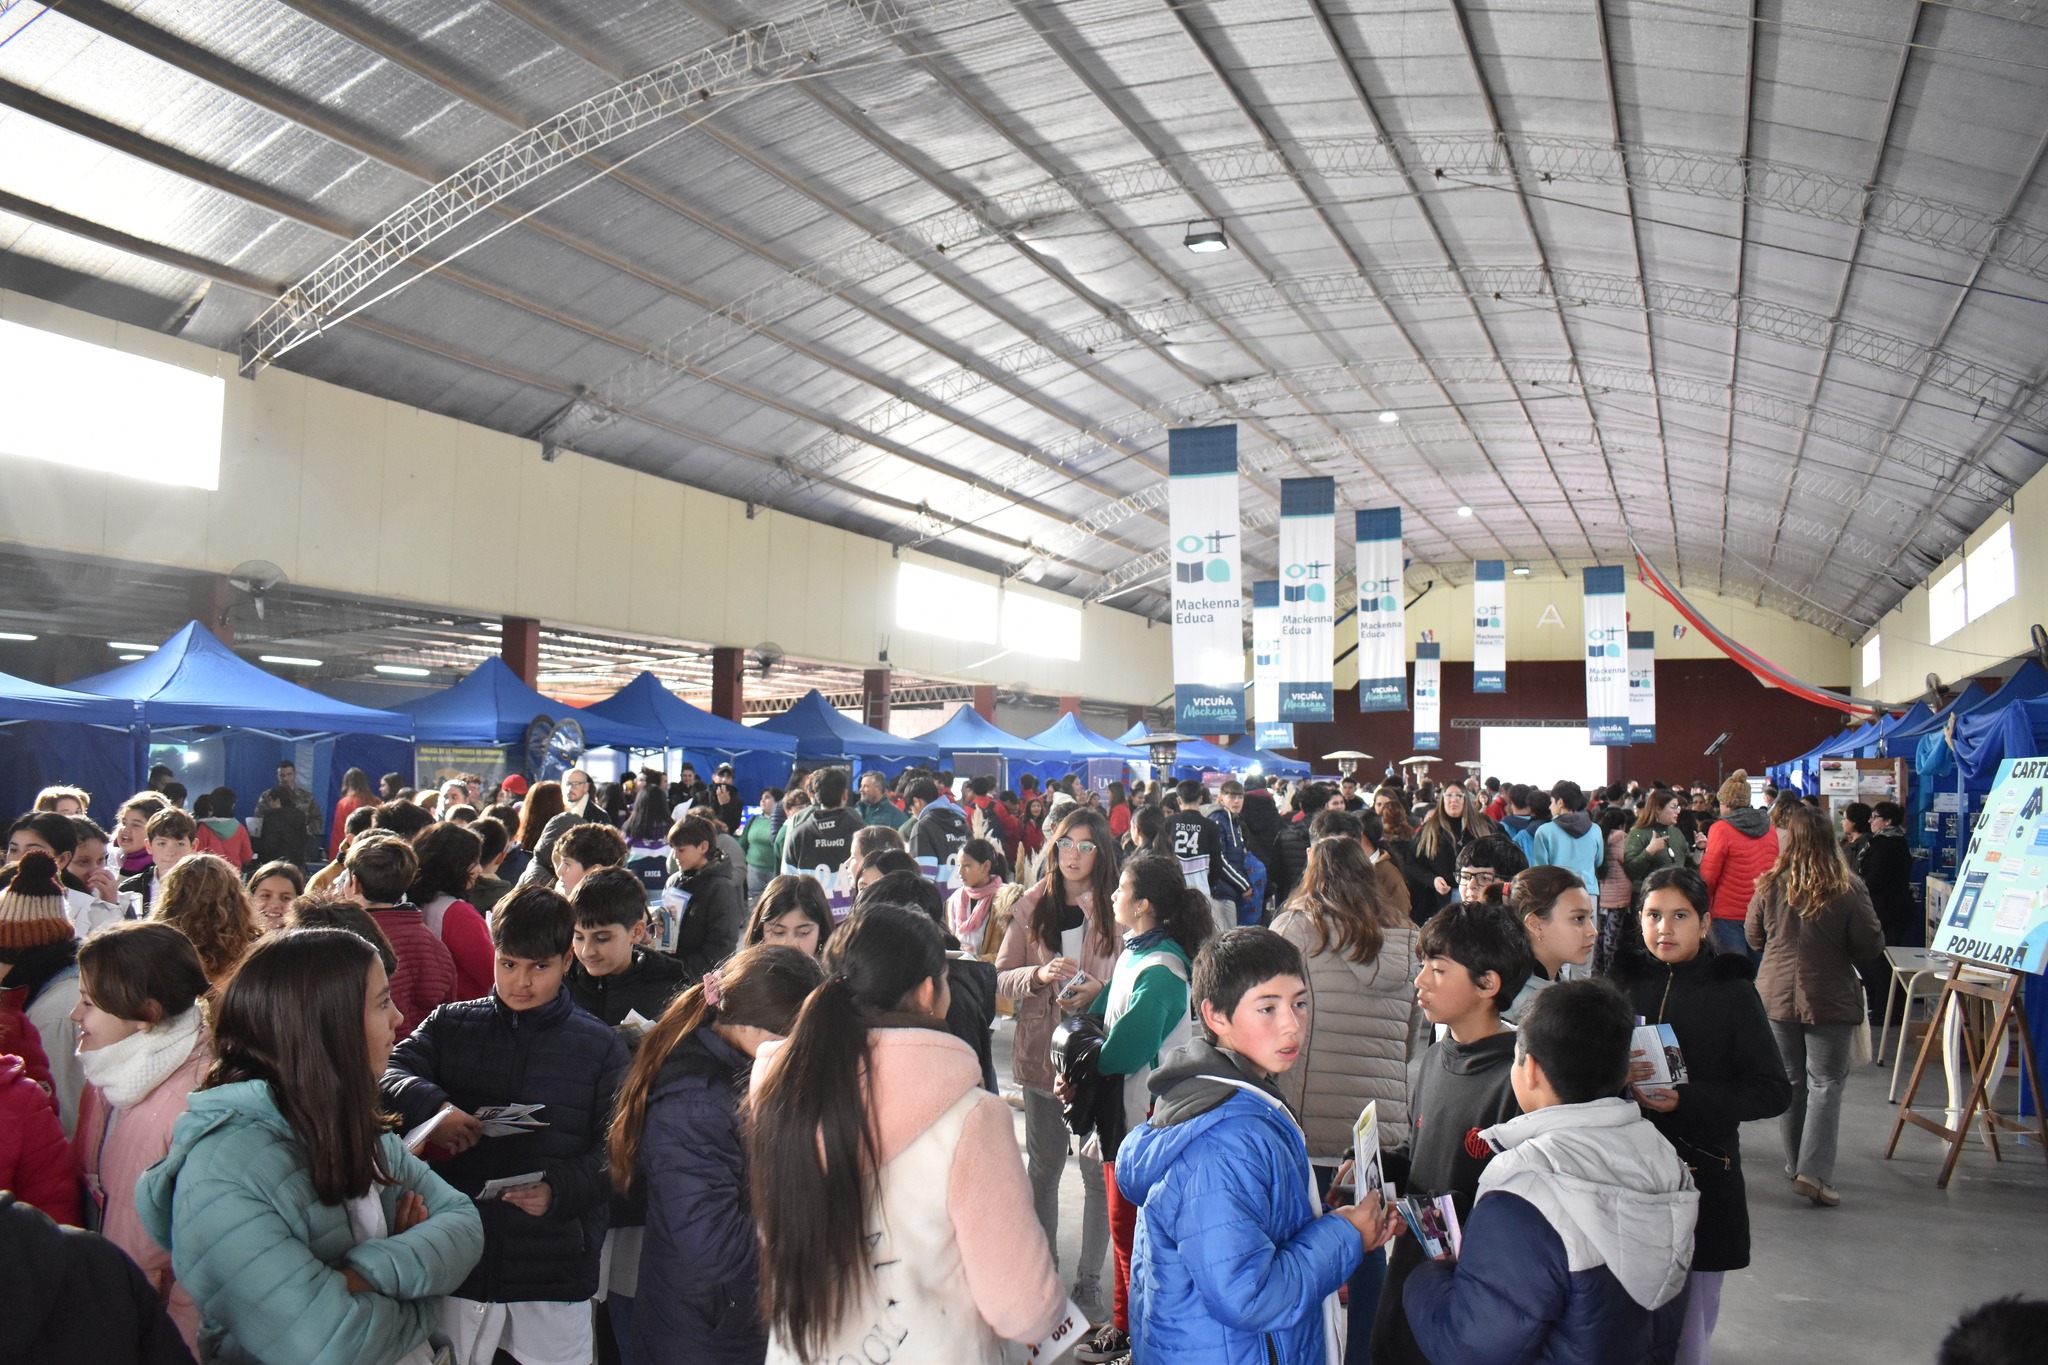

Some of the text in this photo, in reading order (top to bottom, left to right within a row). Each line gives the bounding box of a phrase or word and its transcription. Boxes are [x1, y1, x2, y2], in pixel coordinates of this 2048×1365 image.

[1176, 598, 1239, 610] Mackenna
[1176, 612, 1214, 624] Educa
[1282, 614, 1333, 624] Mackenna
[1282, 626, 1312, 635] Educa
[1360, 621, 1402, 630] Mackenna
[1361, 631, 1386, 639] Educa
[1371, 685, 1399, 694] VICUÑA
[1193, 695, 1234, 706] VICUÑA
[1291, 691, 1323, 700] VICUÑA
[1284, 698, 1327, 711] Mackenna
[1183, 704, 1238, 719] Mackenna
[1598, 724, 1623, 732] VICUÑA
[1175, 822, 1202, 832] PROMO
[815, 839, 845, 848] PROMO
[1174, 831, 1199, 854] 24
[815, 863, 852, 900] 24
